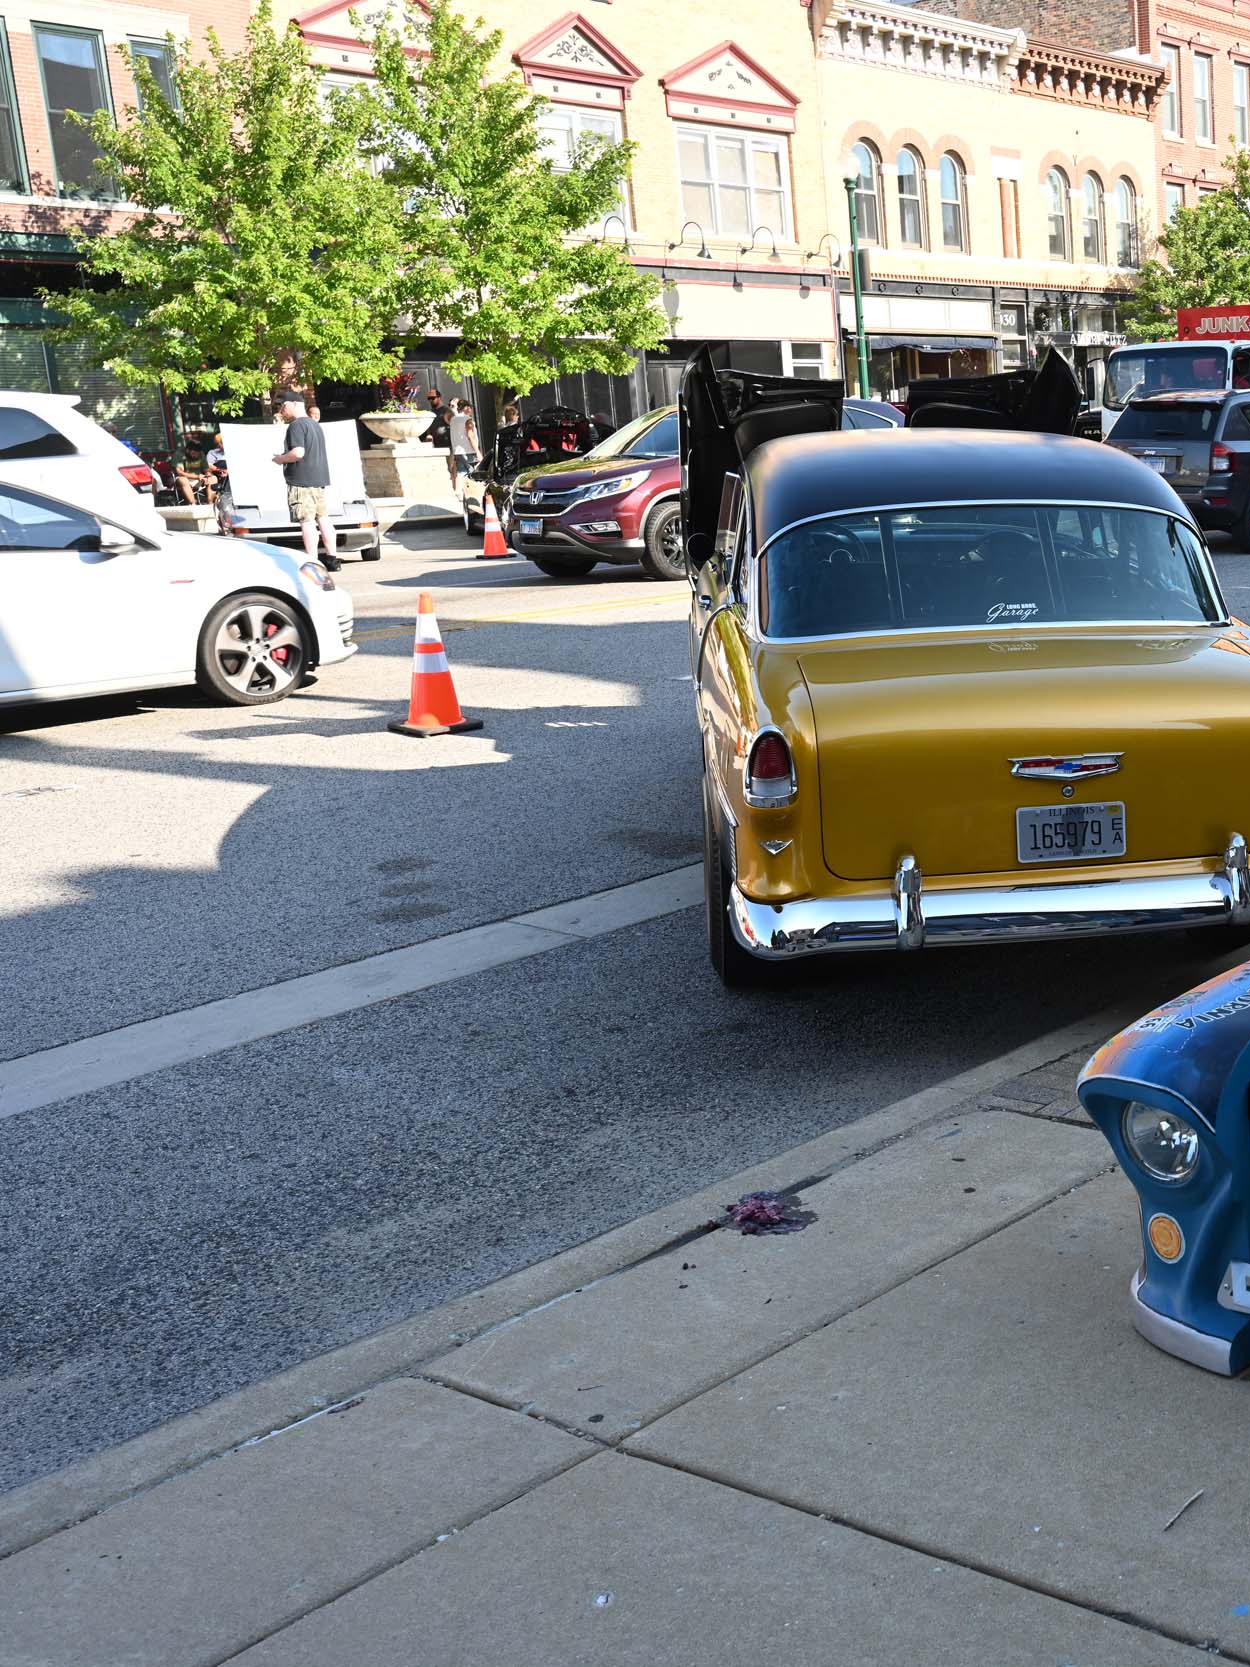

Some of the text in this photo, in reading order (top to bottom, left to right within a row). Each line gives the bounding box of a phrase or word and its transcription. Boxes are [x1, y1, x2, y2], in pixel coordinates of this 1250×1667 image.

[1196, 315, 1250, 334] JUNK
[986, 602, 1039, 623] Garage
[1048, 806, 1095, 817] ILLINOIS
[1030, 820, 1102, 851] 165979
